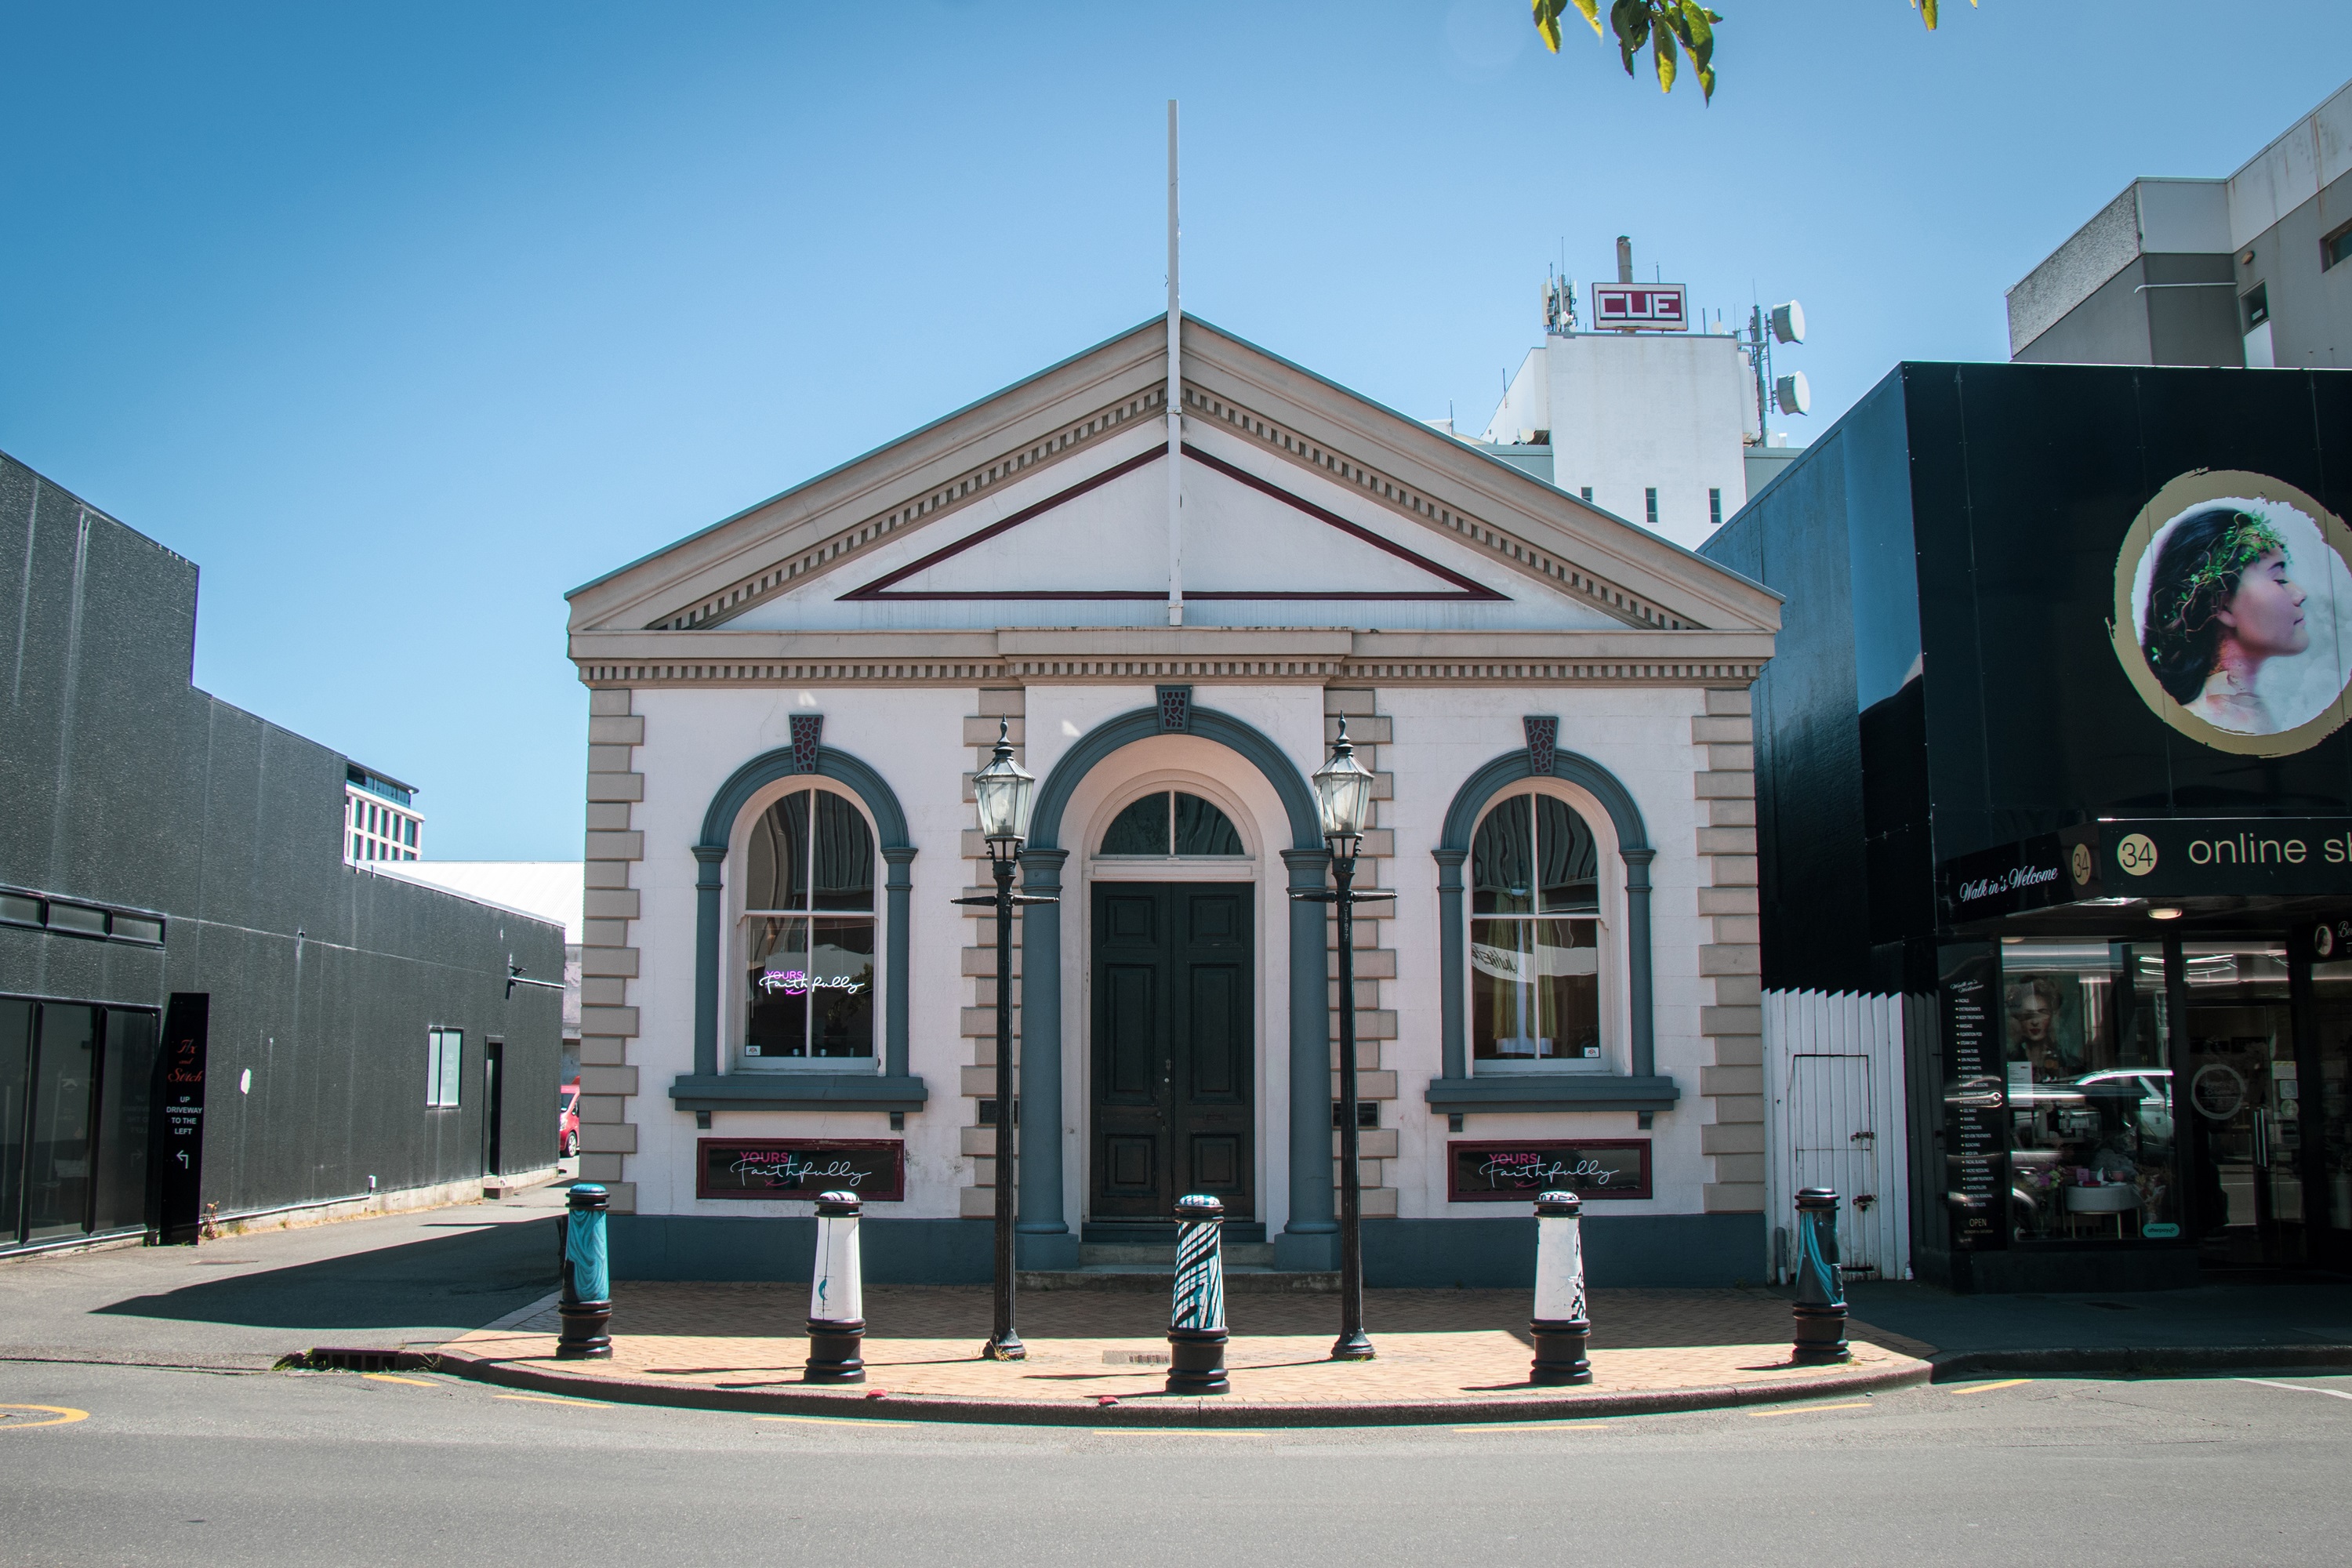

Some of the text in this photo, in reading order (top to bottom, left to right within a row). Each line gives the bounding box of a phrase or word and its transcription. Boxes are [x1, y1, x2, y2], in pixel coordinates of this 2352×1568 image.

[1599, 292, 1680, 319] CUE
[2122, 842, 2154, 868] 34
[2188, 833, 2307, 864] online
[2074, 851, 2089, 878] 34
[1960, 866, 2059, 902] Walk in's Welcome
[758, 973, 866, 994] Faithfully
[766, 971, 804, 980] YOURS
[168, 1068, 203, 1082] Stitch
[739, 1152, 789, 1163] YOURS
[1489, 1153, 1537, 1164] YOURS
[730, 1155, 872, 1186] Faithfully
[1479, 1155, 1620, 1188] Faithfully
[1969, 1218, 1987, 1227] OPEN
